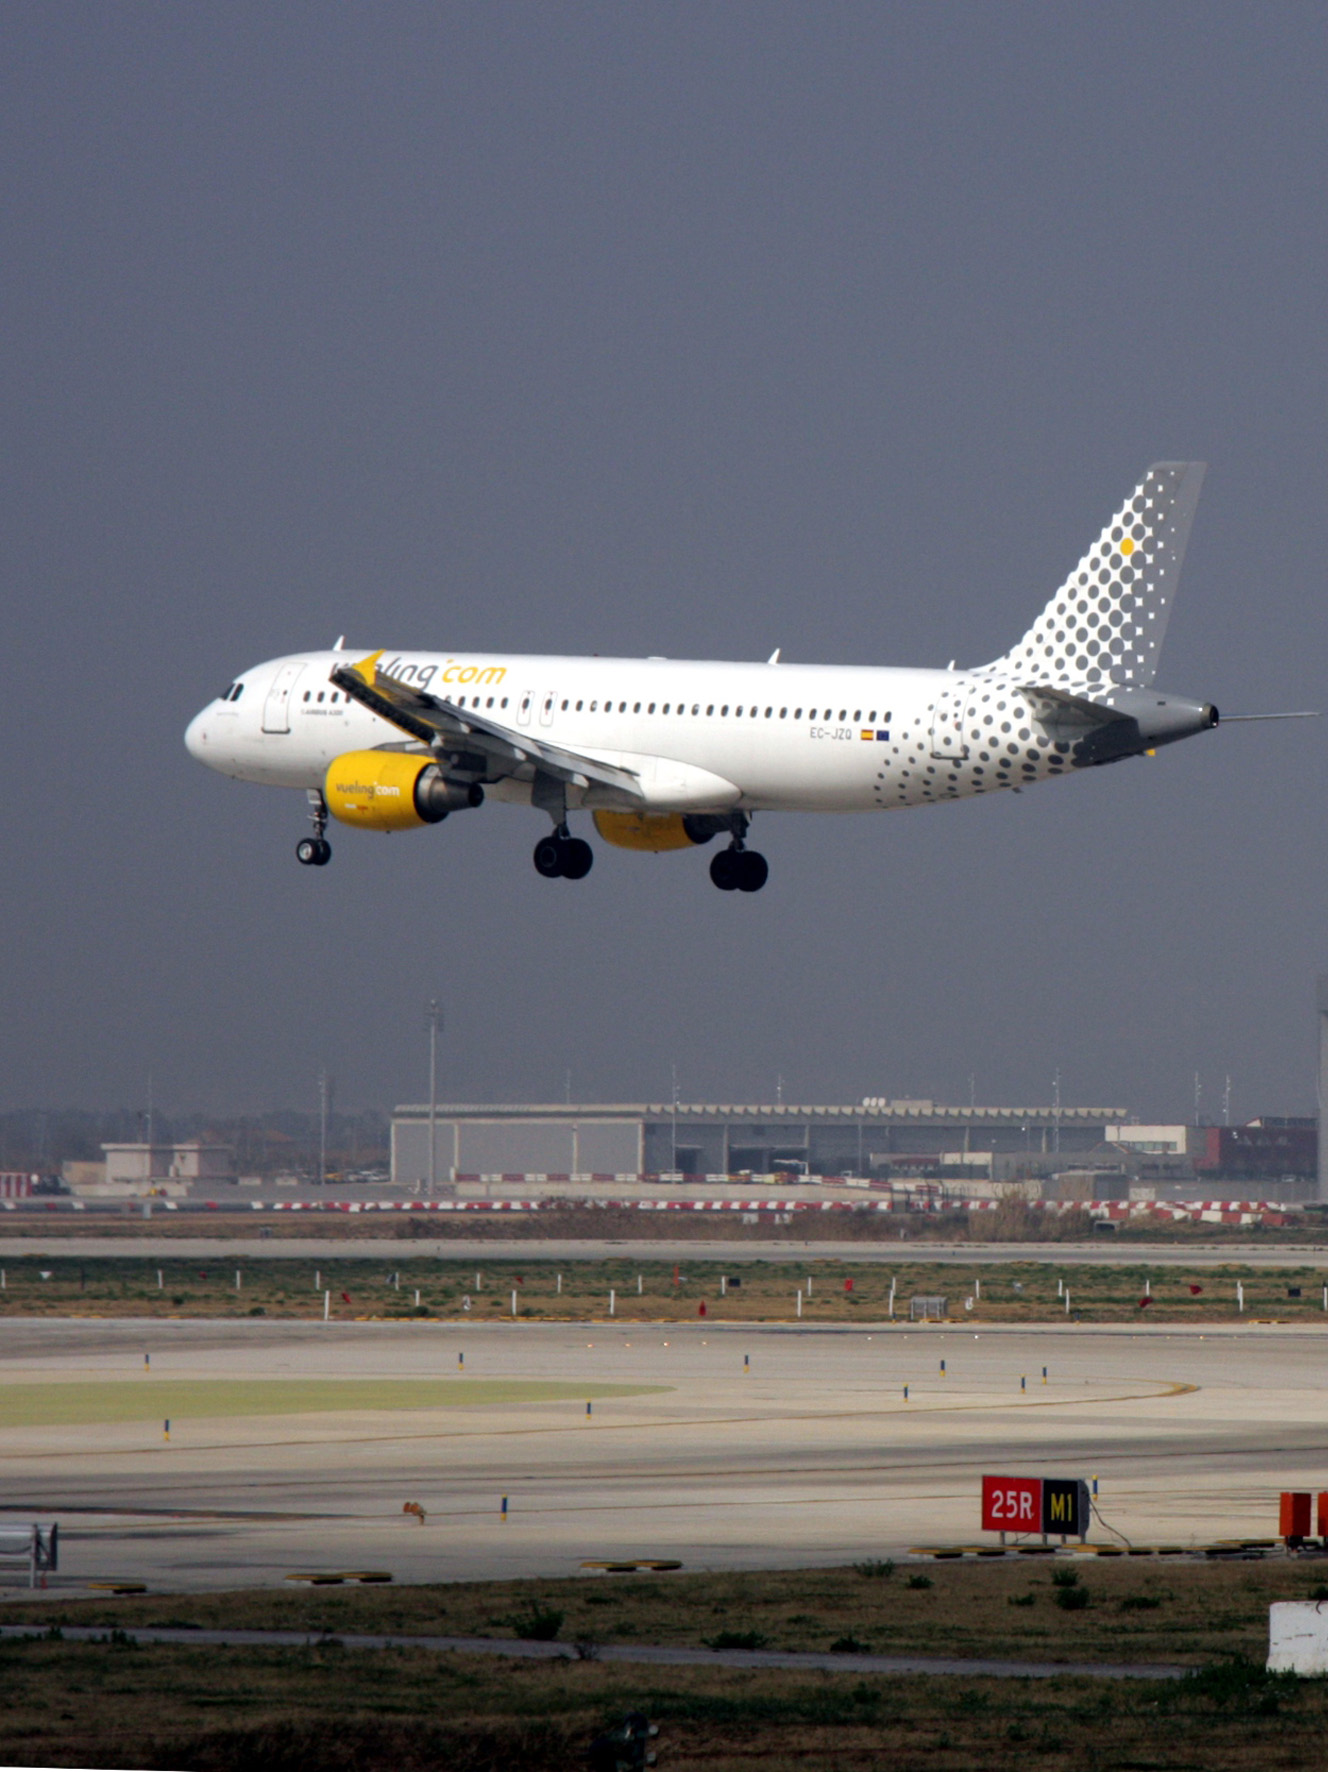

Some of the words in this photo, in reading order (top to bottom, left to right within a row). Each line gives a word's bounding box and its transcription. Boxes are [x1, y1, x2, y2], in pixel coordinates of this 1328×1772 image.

[810, 727, 852, 740] EC-JZQ
[991, 1490, 1032, 1519] 25R
[1051, 1493, 1073, 1522] M1
